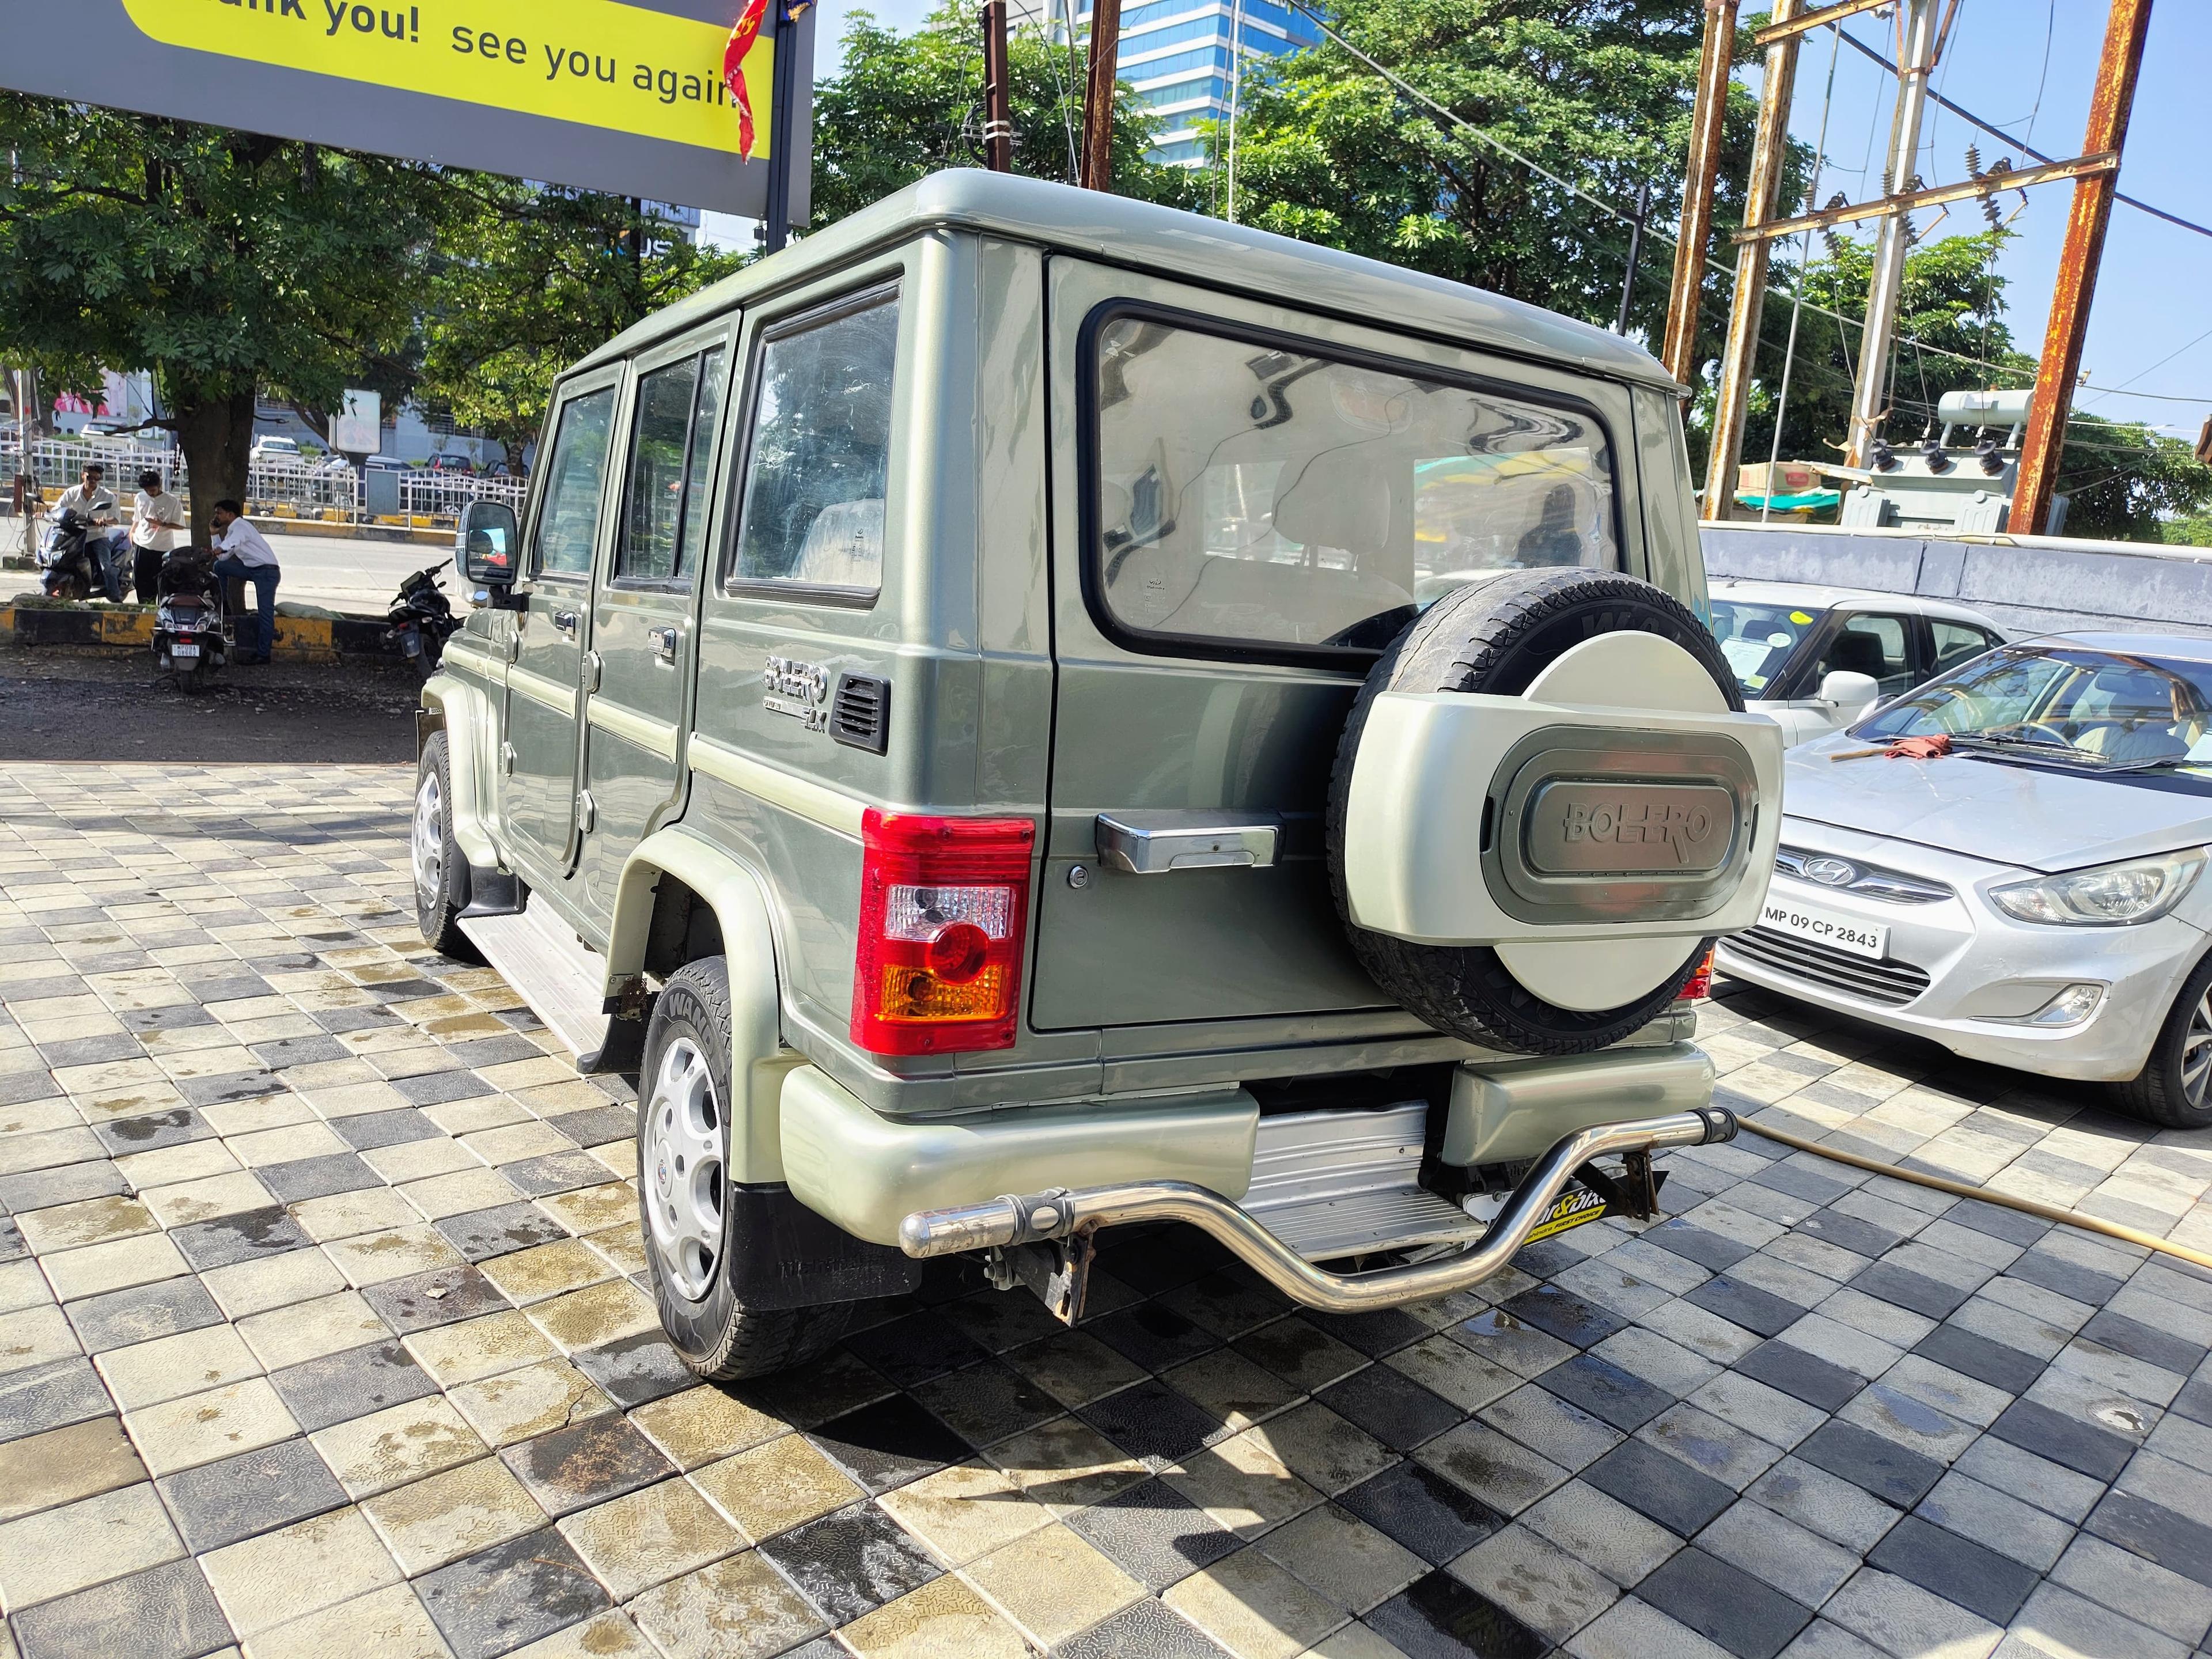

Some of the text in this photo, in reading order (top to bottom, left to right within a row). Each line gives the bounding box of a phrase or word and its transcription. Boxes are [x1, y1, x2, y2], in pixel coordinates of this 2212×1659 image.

[323, 0, 419, 43] you!
[452, 26, 527, 64] see
[544, 45, 616, 84] you
[764, 655, 828, 706] BOLERO
[1562, 802, 1712, 863] BOLERO
[1765, 906, 1877, 948] MP 09 CP 2843
